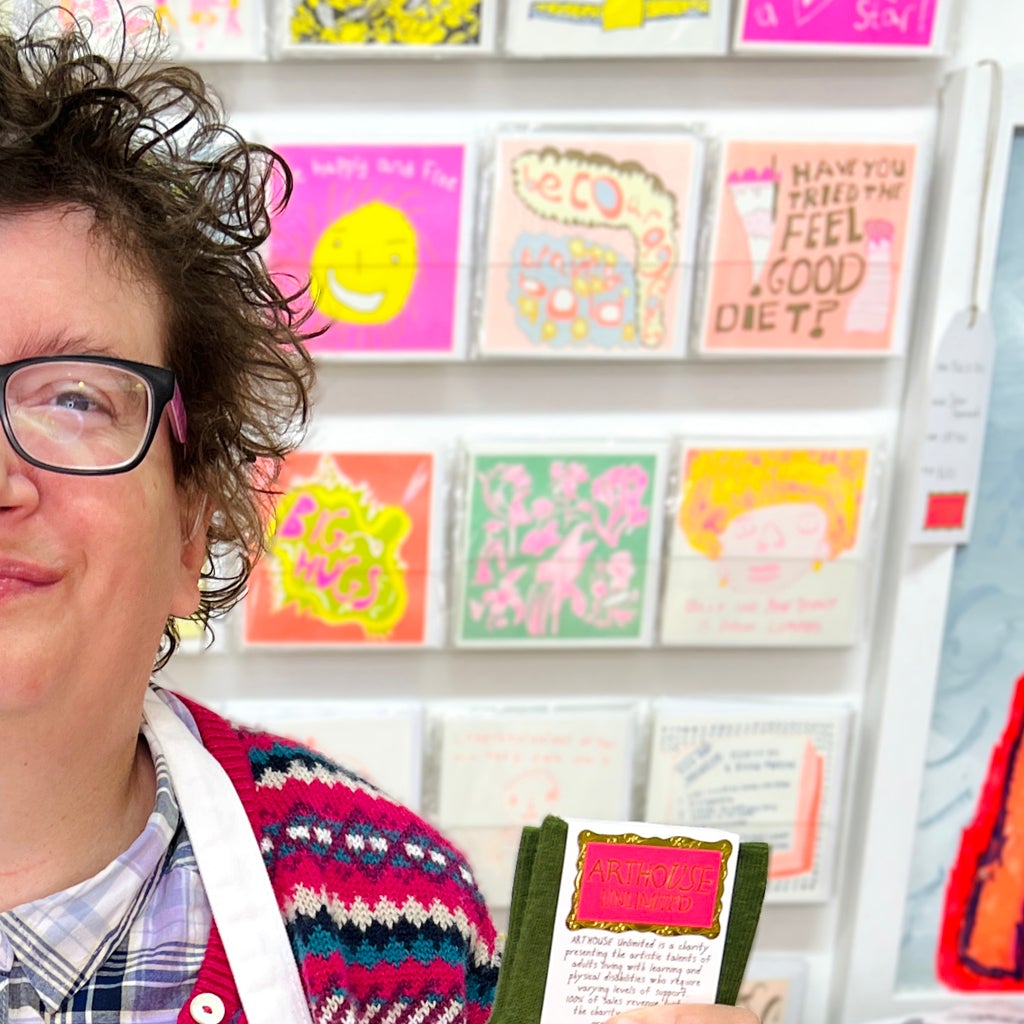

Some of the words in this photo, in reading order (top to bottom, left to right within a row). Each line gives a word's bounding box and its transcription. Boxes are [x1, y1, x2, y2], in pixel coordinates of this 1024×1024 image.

[792, 158, 857, 186] HAVE
[863, 158, 906, 178] YOU
[788, 182, 859, 211] TRIED
[864, 182, 904, 202] THE
[781, 206, 864, 252] FEEL
[767, 252, 867, 296] GOOD
[715, 299, 840, 339] DIET?
[279, 493, 350, 553] BIG
[294, 548, 383, 612] HUGS
[586, 859, 715, 895] ARTHOUSE
[601, 888, 693, 914] UNLIMITED
[564, 947, 608, 964] presenting
[612, 948, 626, 959] the
[629, 950, 662, 961] artistic
[666, 952, 697, 963] talents
[700, 954, 712, 963] of
[571, 935, 614, 946] ARTHOUSE
[617, 938, 656, 948] Unlimited
[678, 940, 709, 956] charity
[567, 970, 601, 985] physical
[650, 974, 666, 984] who
[572, 958, 597, 969] adults
[627, 962, 646, 972] with
[649, 964, 682, 980] learning
[686, 964, 703, 975] and
[566, 995, 584, 1003] 100%
[587, 995, 599, 1004] of
[602, 996, 623, 1005] sales
[577, 985, 609, 1001] varying
[613, 985, 636, 995] levels
[640, 986, 651, 995] of
[573, 1005, 587, 1016] the
